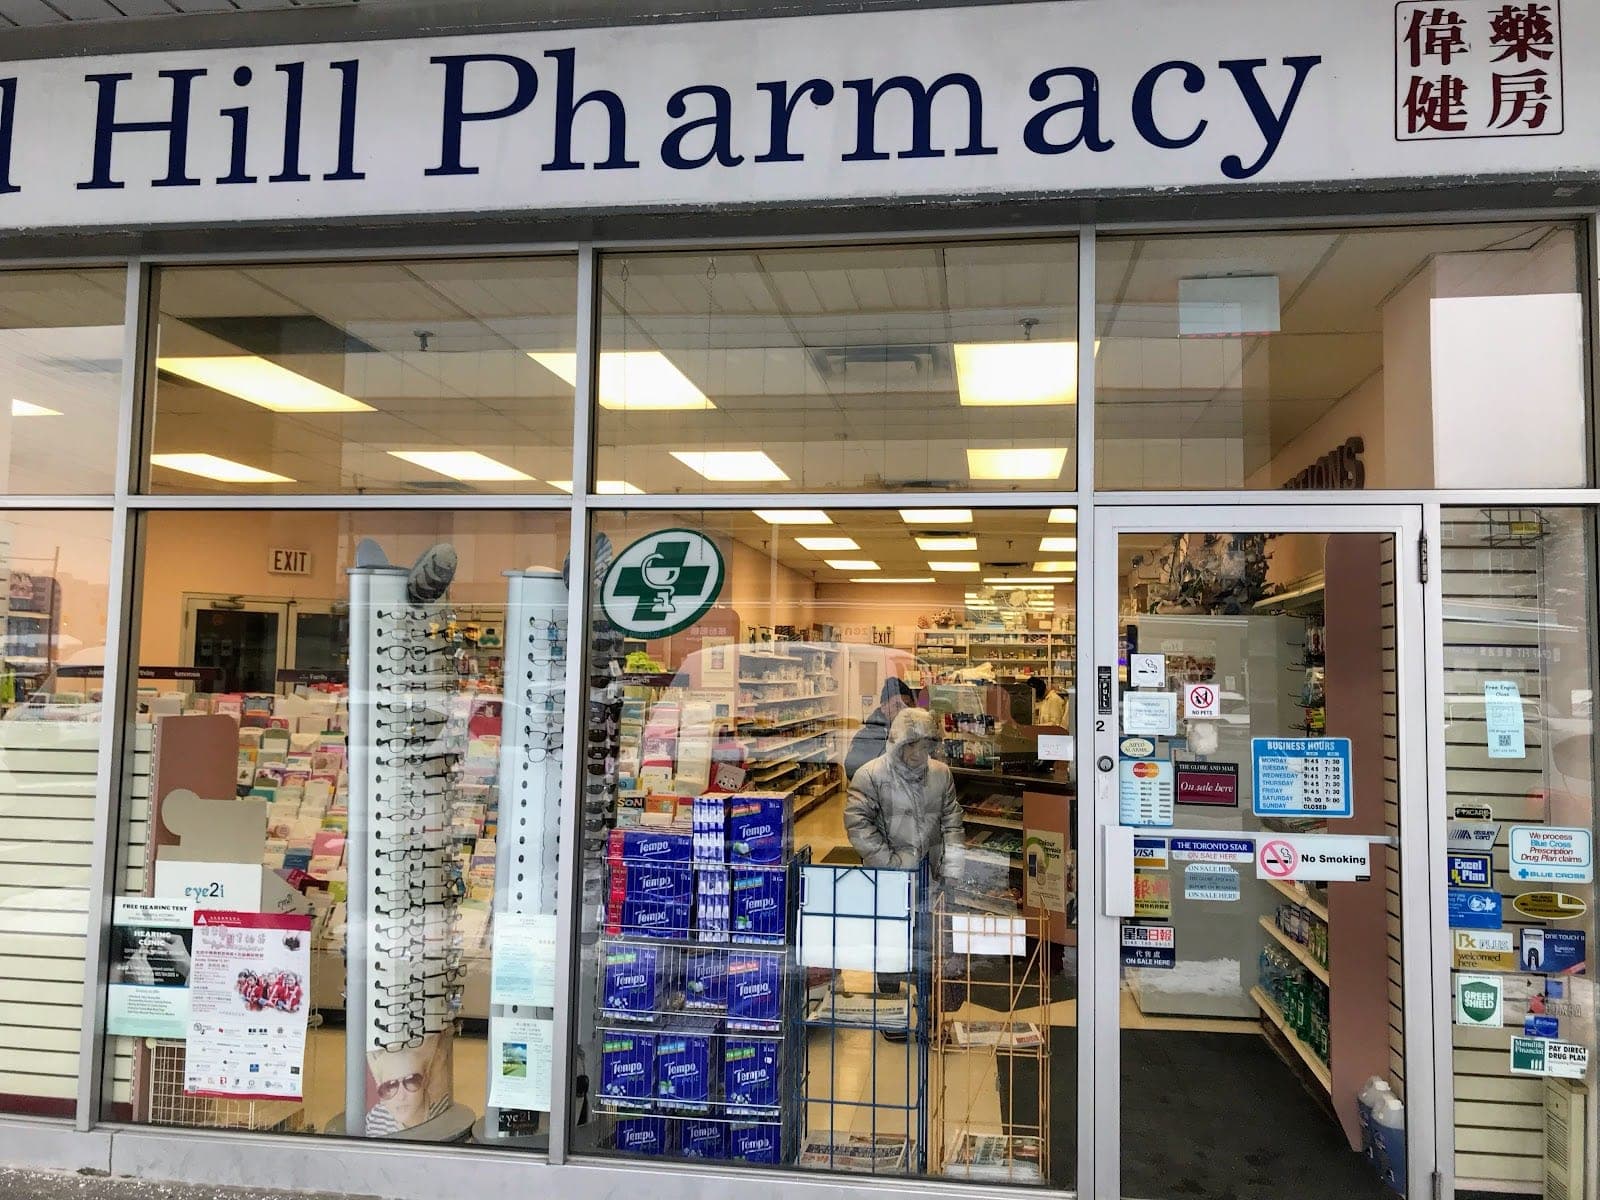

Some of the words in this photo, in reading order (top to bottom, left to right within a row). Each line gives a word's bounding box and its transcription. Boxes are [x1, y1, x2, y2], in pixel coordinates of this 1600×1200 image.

[76, 59, 366, 190] Hill
[424, 47, 1322, 180] Pharmacy
[273, 550, 308, 574] EXIT
[872, 631, 892, 645] EXIT
[1267, 741, 1306, 751] BUSINESS
[1307, 741, 1336, 751] HOURS
[1180, 781, 1194, 791] On
[1195, 782, 1213, 792] sale
[1214, 782, 1234, 793] here
[617, 798, 643, 808] SON
[739, 824, 771, 839] Tempo
[1542, 833, 1573, 841] process
[636, 839, 669, 855] Tempo
[1177, 841, 1191, 849] THE
[1192, 842, 1229, 850] TORONTO
[1230, 843, 1248, 851] STAR
[1529, 847, 1574, 855] Prescription
[1134, 848, 1154, 857] VISA
[1187, 851, 1199, 859] ON
[1200, 852, 1218, 860] SALE
[1520, 854, 1538, 863] Drug
[1540, 854, 1557, 862] Plan
[1558, 855, 1582, 863] claims
[1301, 854, 1317, 863] No
[1319, 854, 1366, 866] Smoking
[1455, 858, 1482, 870] Excel
[1462, 870, 1486, 881] Plan
[639, 875, 671, 889] Tempo
[184, 882, 225, 903] eye2i
[742, 896, 774, 911] Tempo
[635, 910, 666, 924] Tempo
[134, 930, 171, 938] HEARING
[1123, 927, 1172, 941] 星島日報
[1458, 952, 1501, 961] welcomed
[1458, 958, 1478, 967] here
[694, 964, 725, 978] Tempo
[613, 973, 645, 987] Tempo
[736, 982, 769, 997] Tempo
[1464, 990, 1495, 1001] GREEN
[1464, 999, 1495, 1009] SHIELD
[1514, 1039, 1544, 1048] Manulife
[1548, 1045, 1562, 1053] PAY
[1563, 1046, 1586, 1054] DIRECT
[1514, 1045, 1544, 1055] Financial
[1569, 1054, 1586, 1062] PLAN
[610, 1060, 642, 1075] Tempo
[664, 1061, 696, 1076] Tempo
[734, 1068, 766, 1083] Tempo
[623, 1128, 654, 1142] Tempo
[687, 1125, 718, 1139] Tempo
[738, 1136, 770, 1150] Tempo
